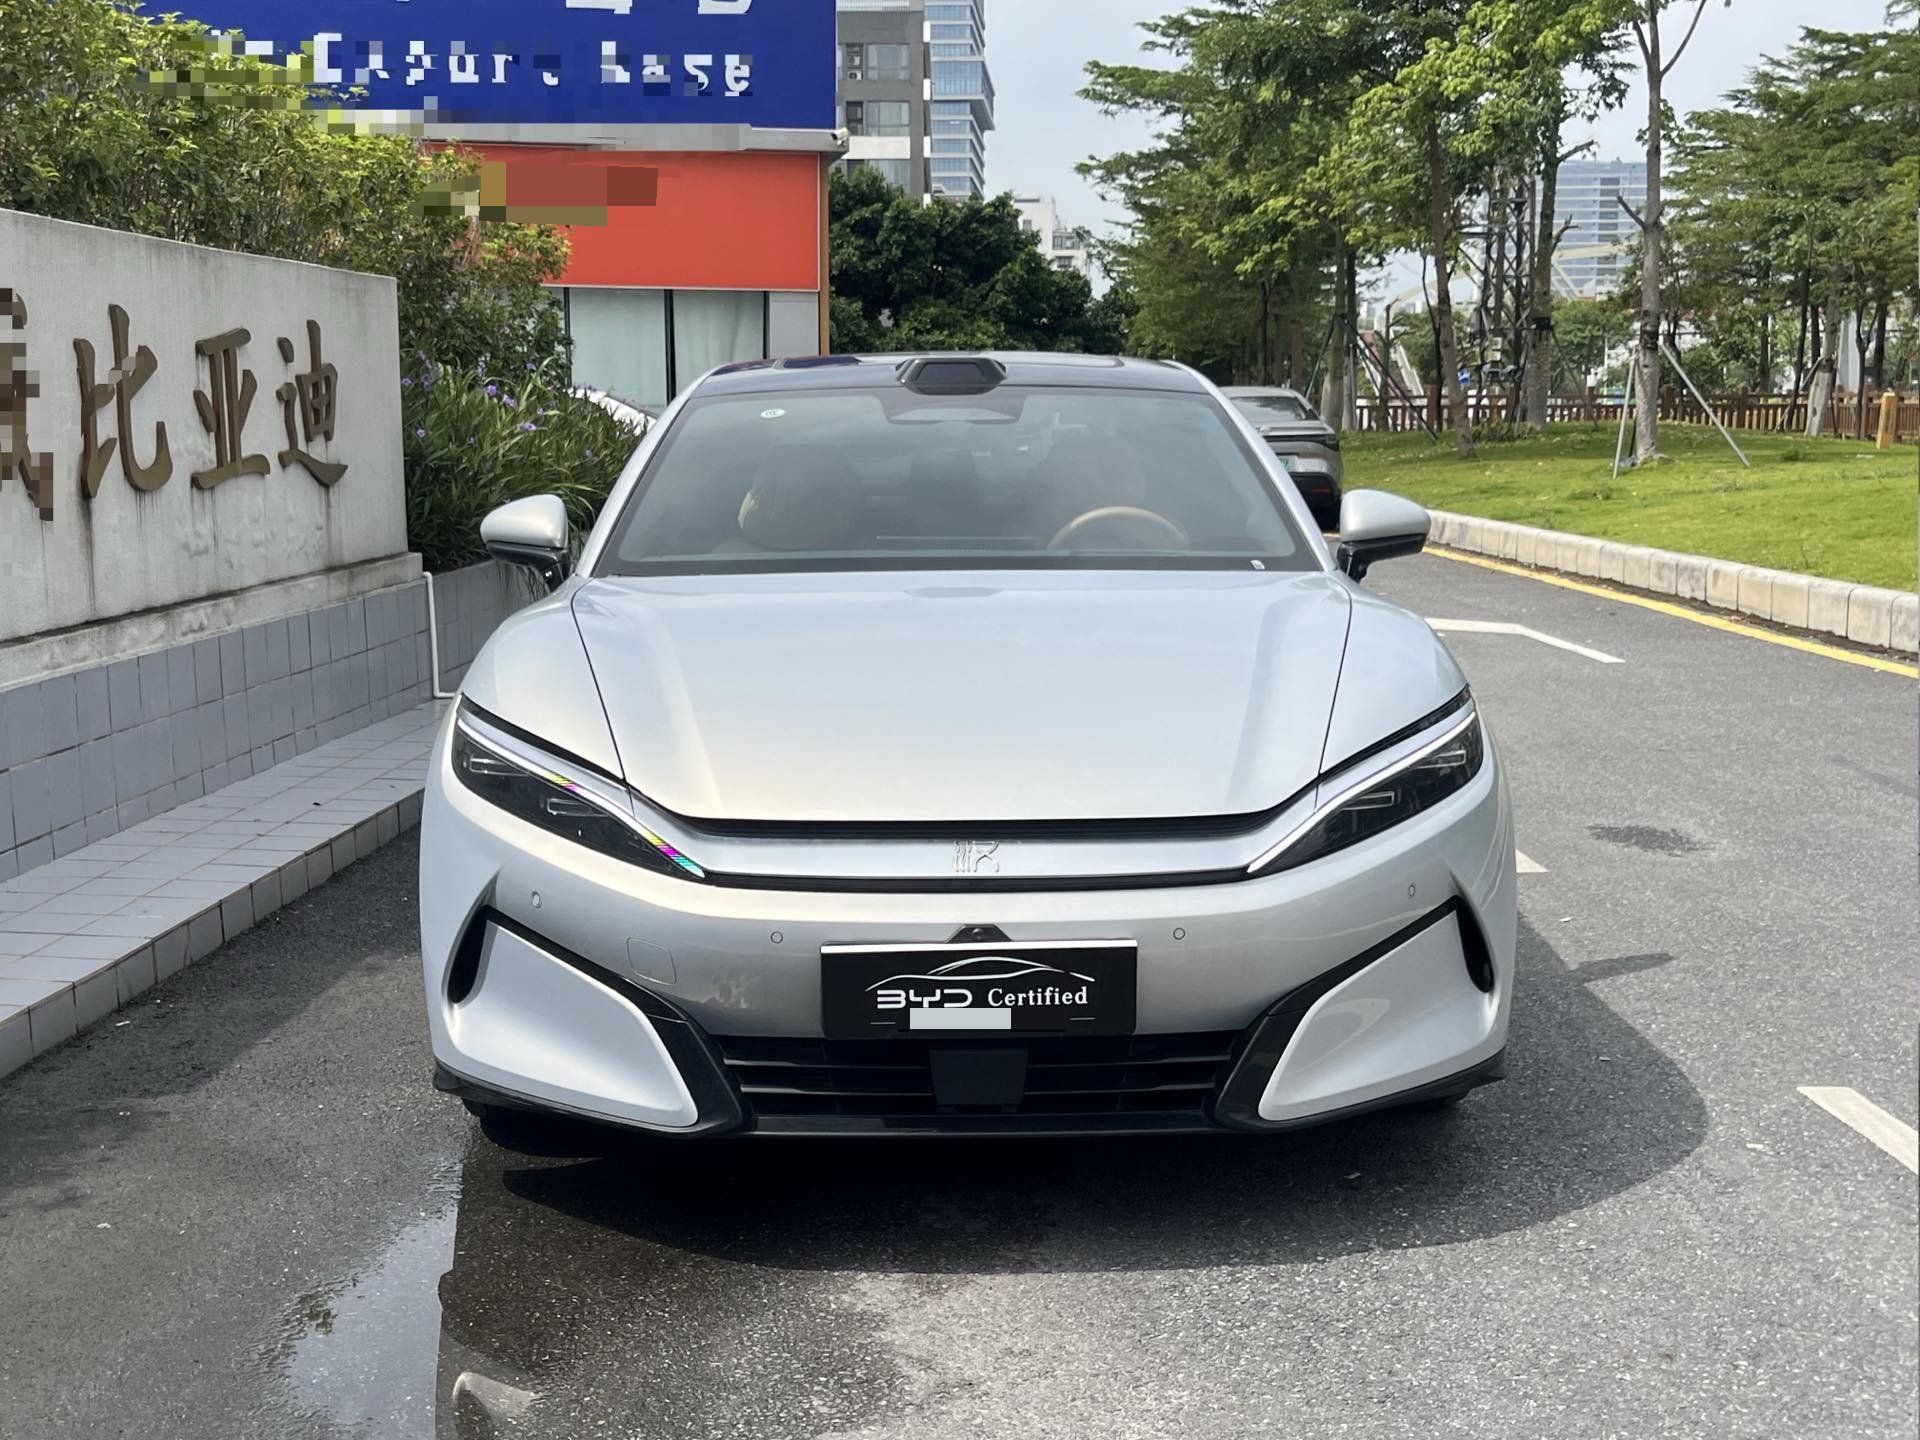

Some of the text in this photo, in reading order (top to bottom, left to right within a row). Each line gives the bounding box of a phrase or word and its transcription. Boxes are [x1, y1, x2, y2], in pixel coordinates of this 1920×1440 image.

[0, 288, 348, 521] 比亚迪
[876, 986, 1088, 1009] BYD Certified
